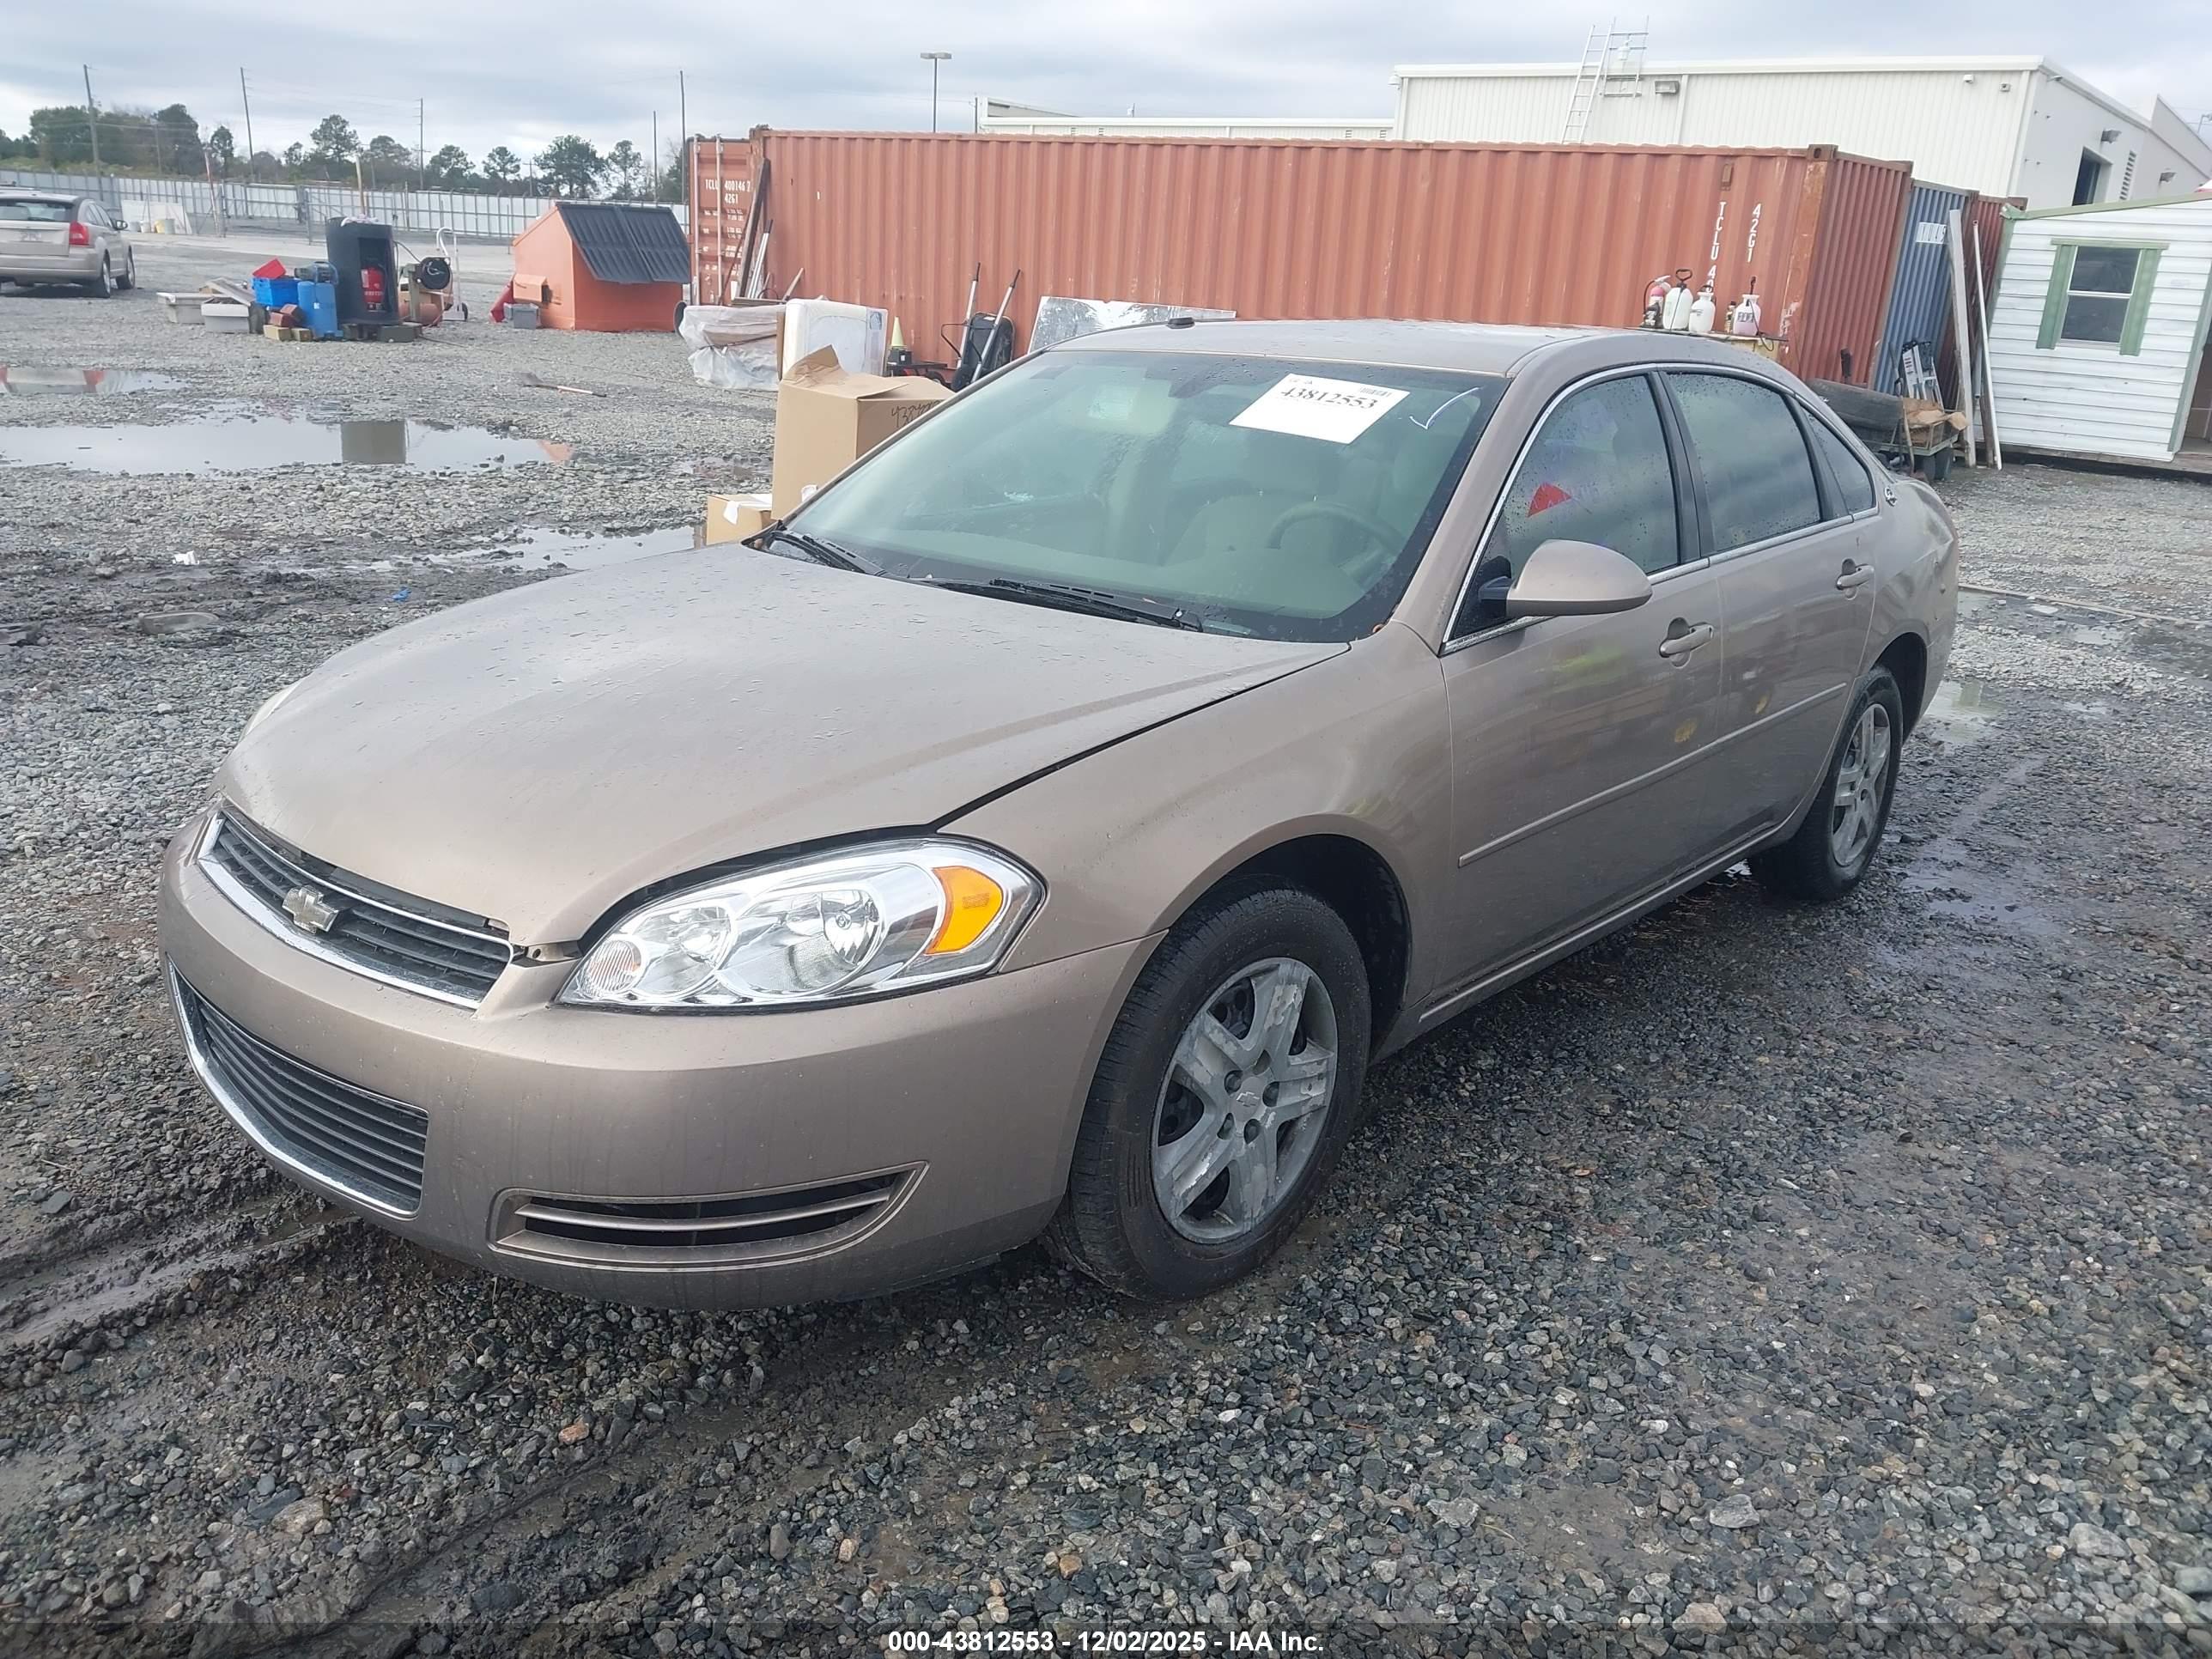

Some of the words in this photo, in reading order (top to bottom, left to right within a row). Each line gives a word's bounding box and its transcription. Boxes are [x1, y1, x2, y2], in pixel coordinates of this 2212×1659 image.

[1711, 202, 1727, 260] TCLU
[1747, 204, 1761, 263] 42G1
[1280, 386, 1378, 409] 43812553
